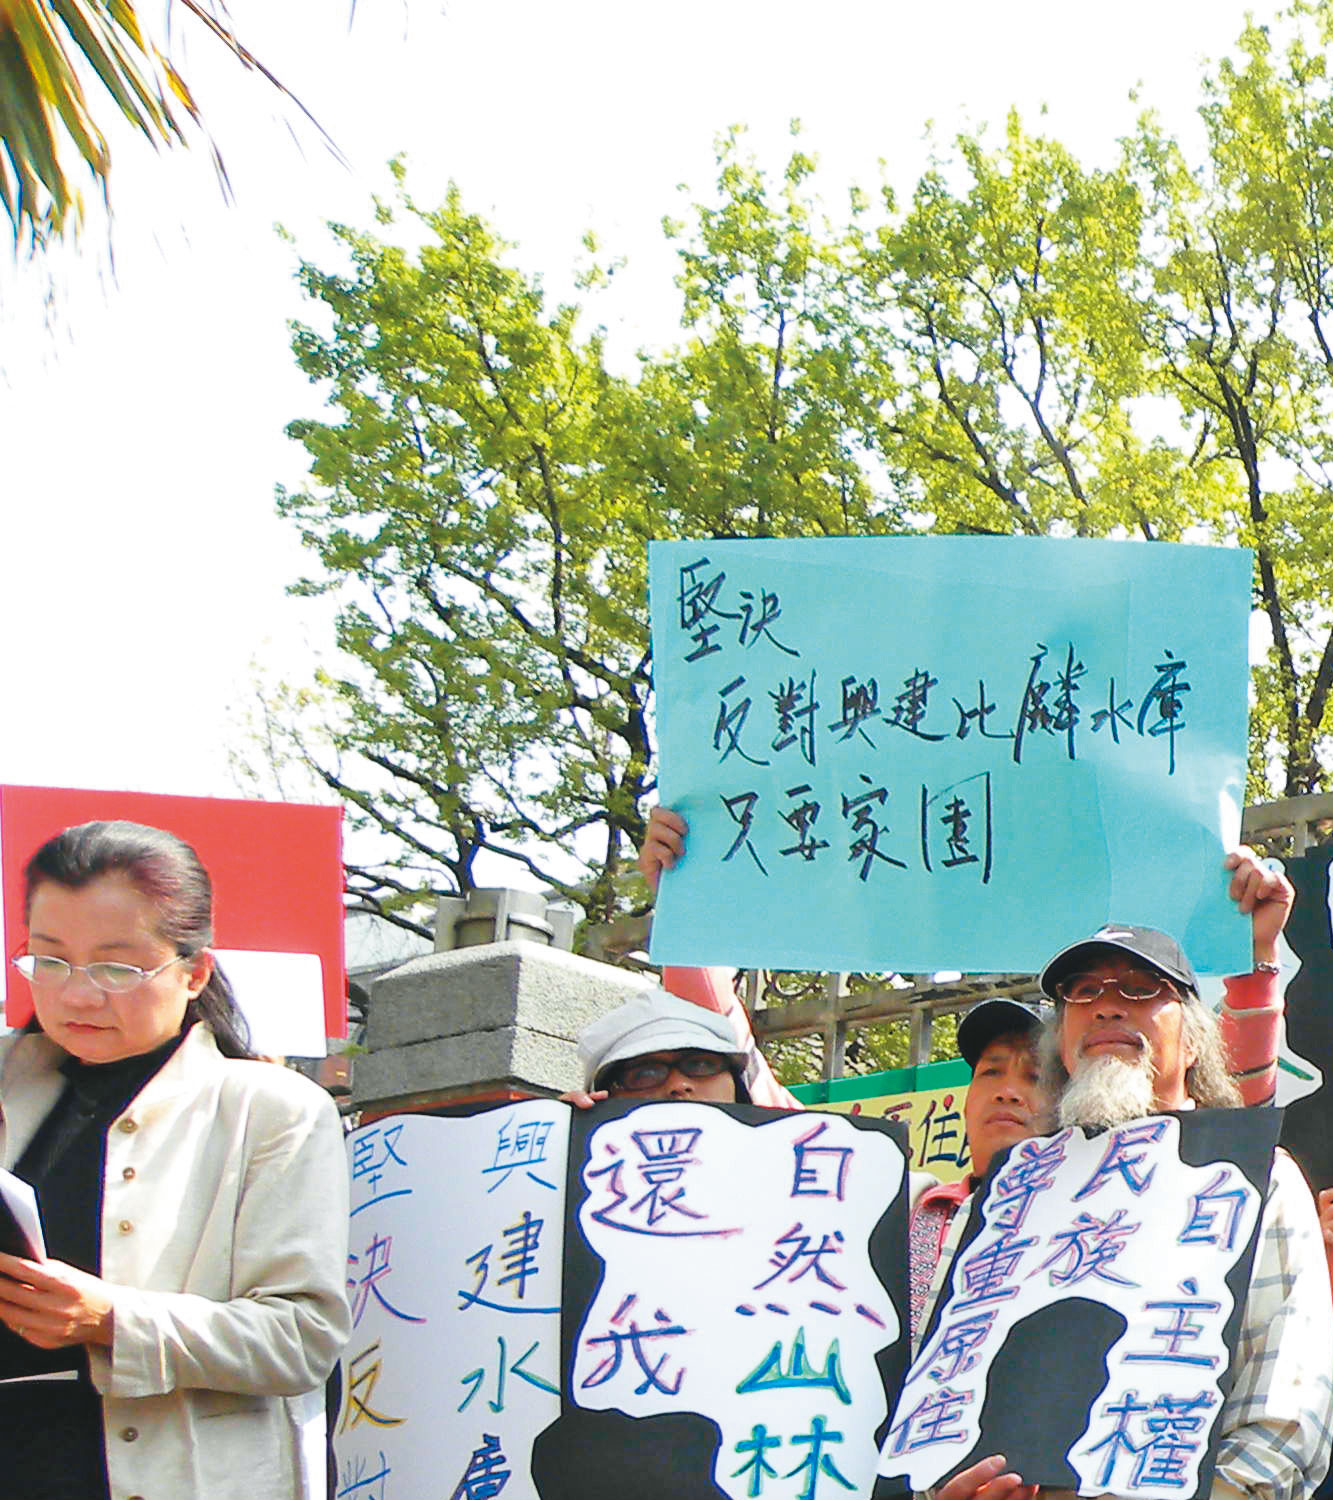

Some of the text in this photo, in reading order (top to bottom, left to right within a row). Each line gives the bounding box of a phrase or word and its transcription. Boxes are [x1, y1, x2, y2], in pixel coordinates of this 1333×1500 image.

[720, 771, 992, 884] 只要家園
[580, 1128, 744, 1395] 還我
[888, 1128, 1074, 1459] 尊重原住
[1025, 1120, 1171, 1289] 民族
[1079, 1169, 1251, 1490] 自主權
